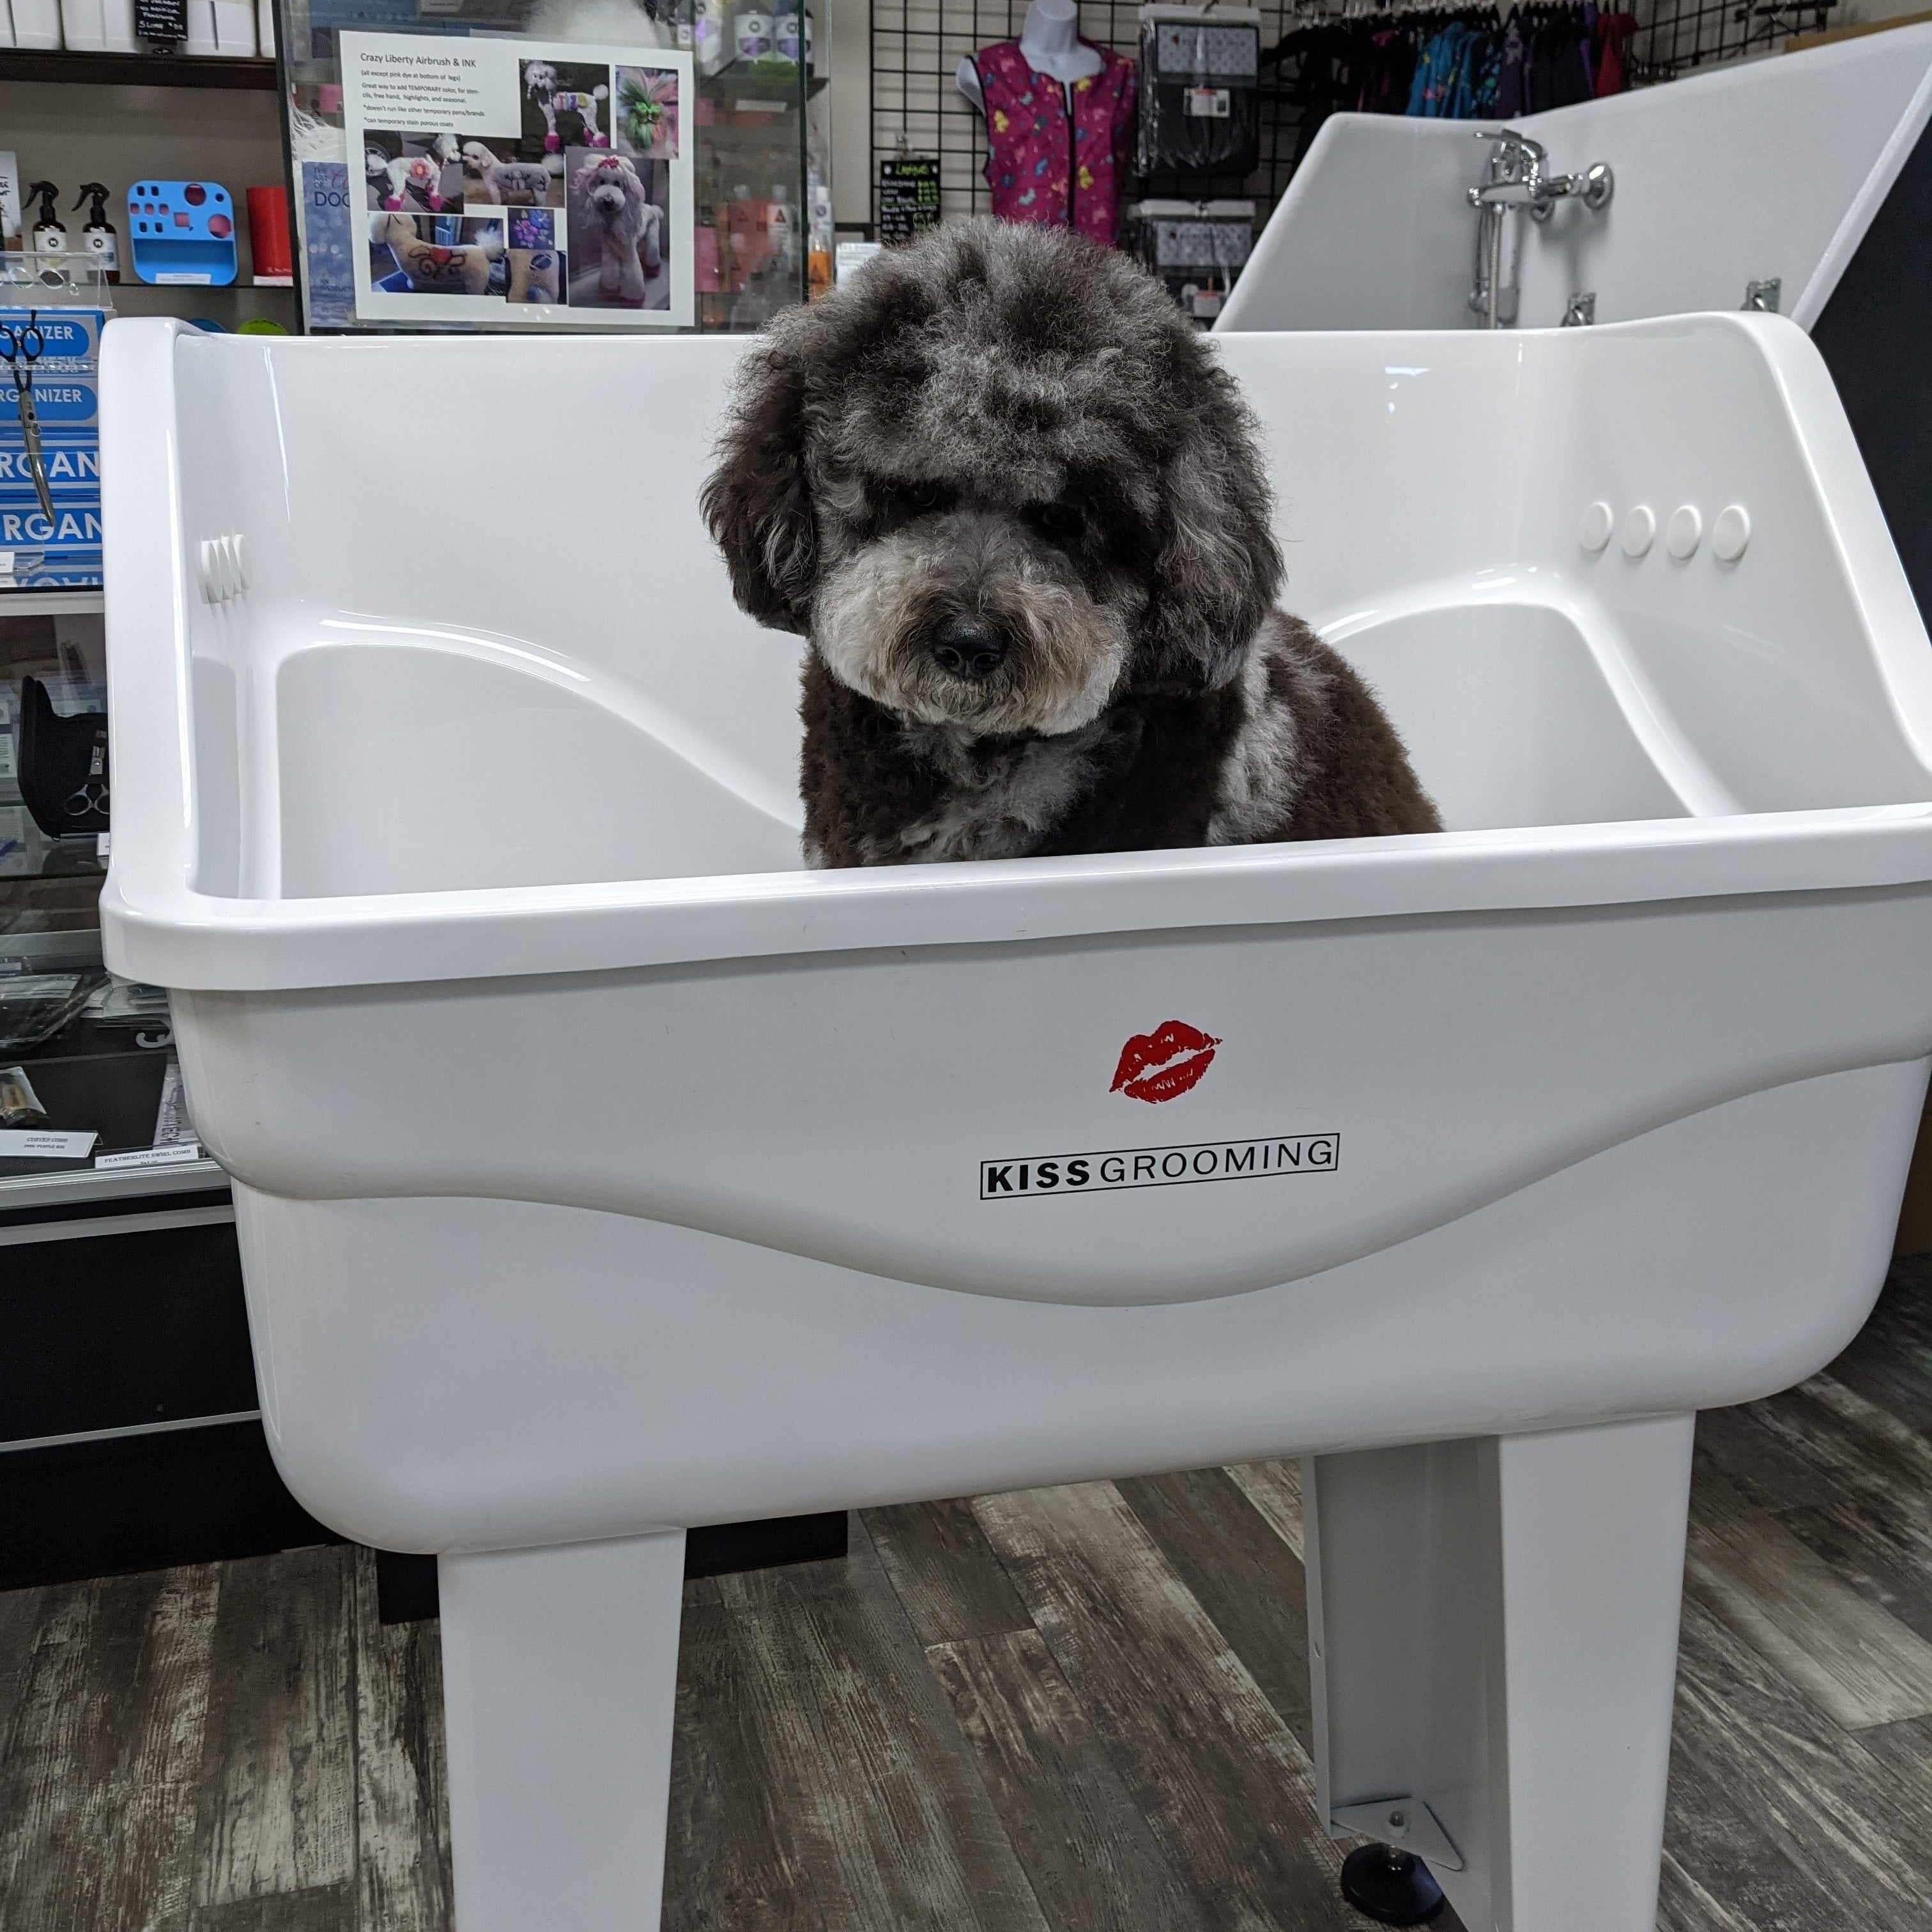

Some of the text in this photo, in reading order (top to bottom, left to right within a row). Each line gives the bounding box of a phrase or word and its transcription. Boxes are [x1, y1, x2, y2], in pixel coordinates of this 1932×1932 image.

[360, 53, 383, 63] Crazy
[385, 54, 413, 65] Liberty
[416, 56, 450, 66] Airbrush
[453, 58, 459, 66] &
[104, 1153, 150, 1163] FEATHERLITE
